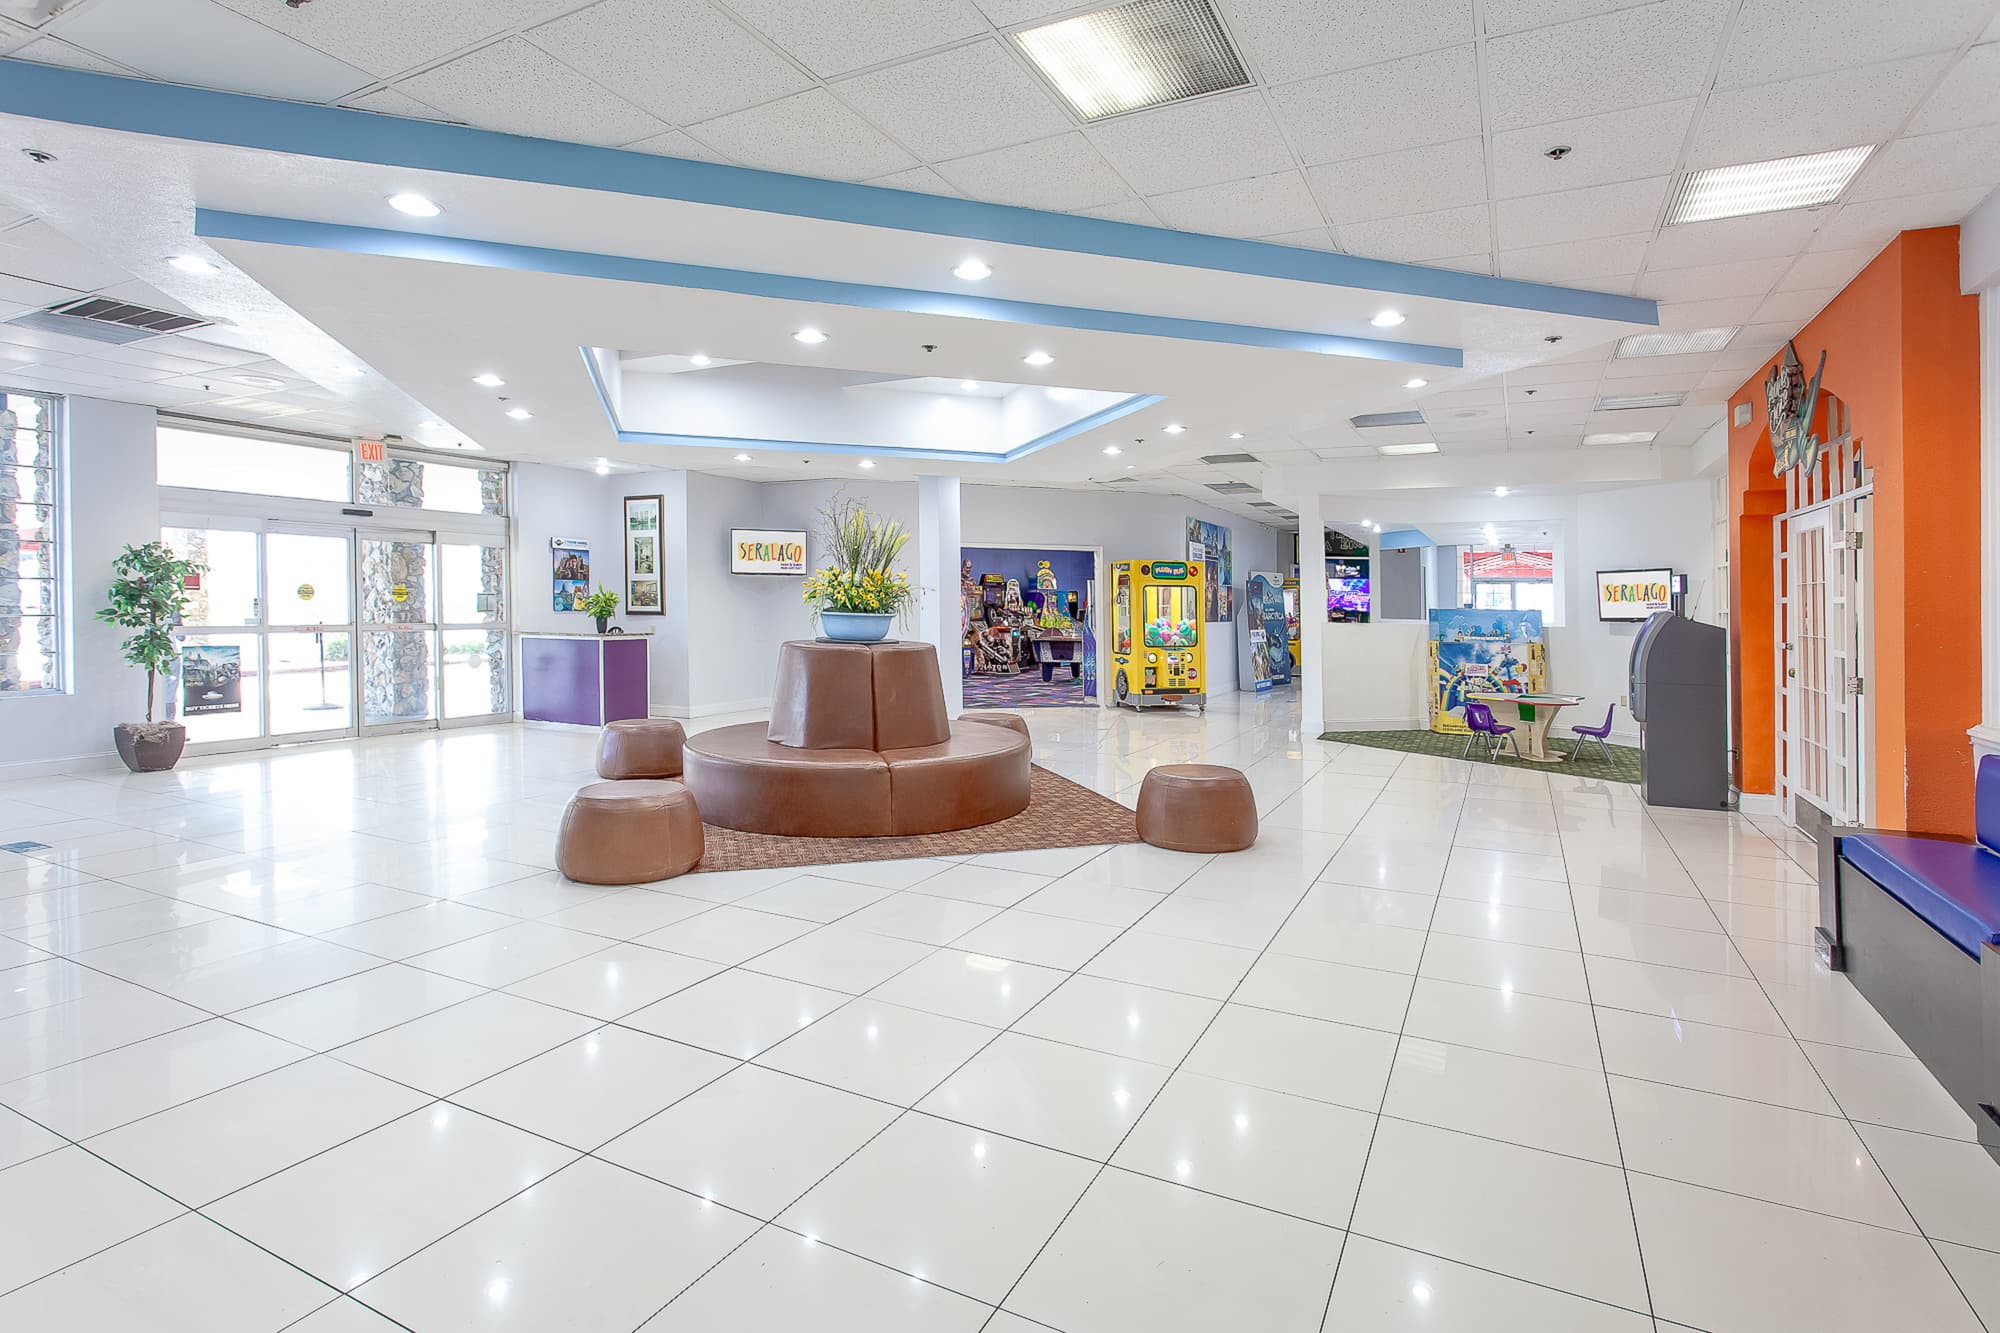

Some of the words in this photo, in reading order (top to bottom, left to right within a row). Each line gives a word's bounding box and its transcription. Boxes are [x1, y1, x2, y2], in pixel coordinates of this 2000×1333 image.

[361, 443, 383, 460] EXIT
[740, 542, 802, 563] SERALAGO
[1606, 582, 1666, 602] SERALAGO
